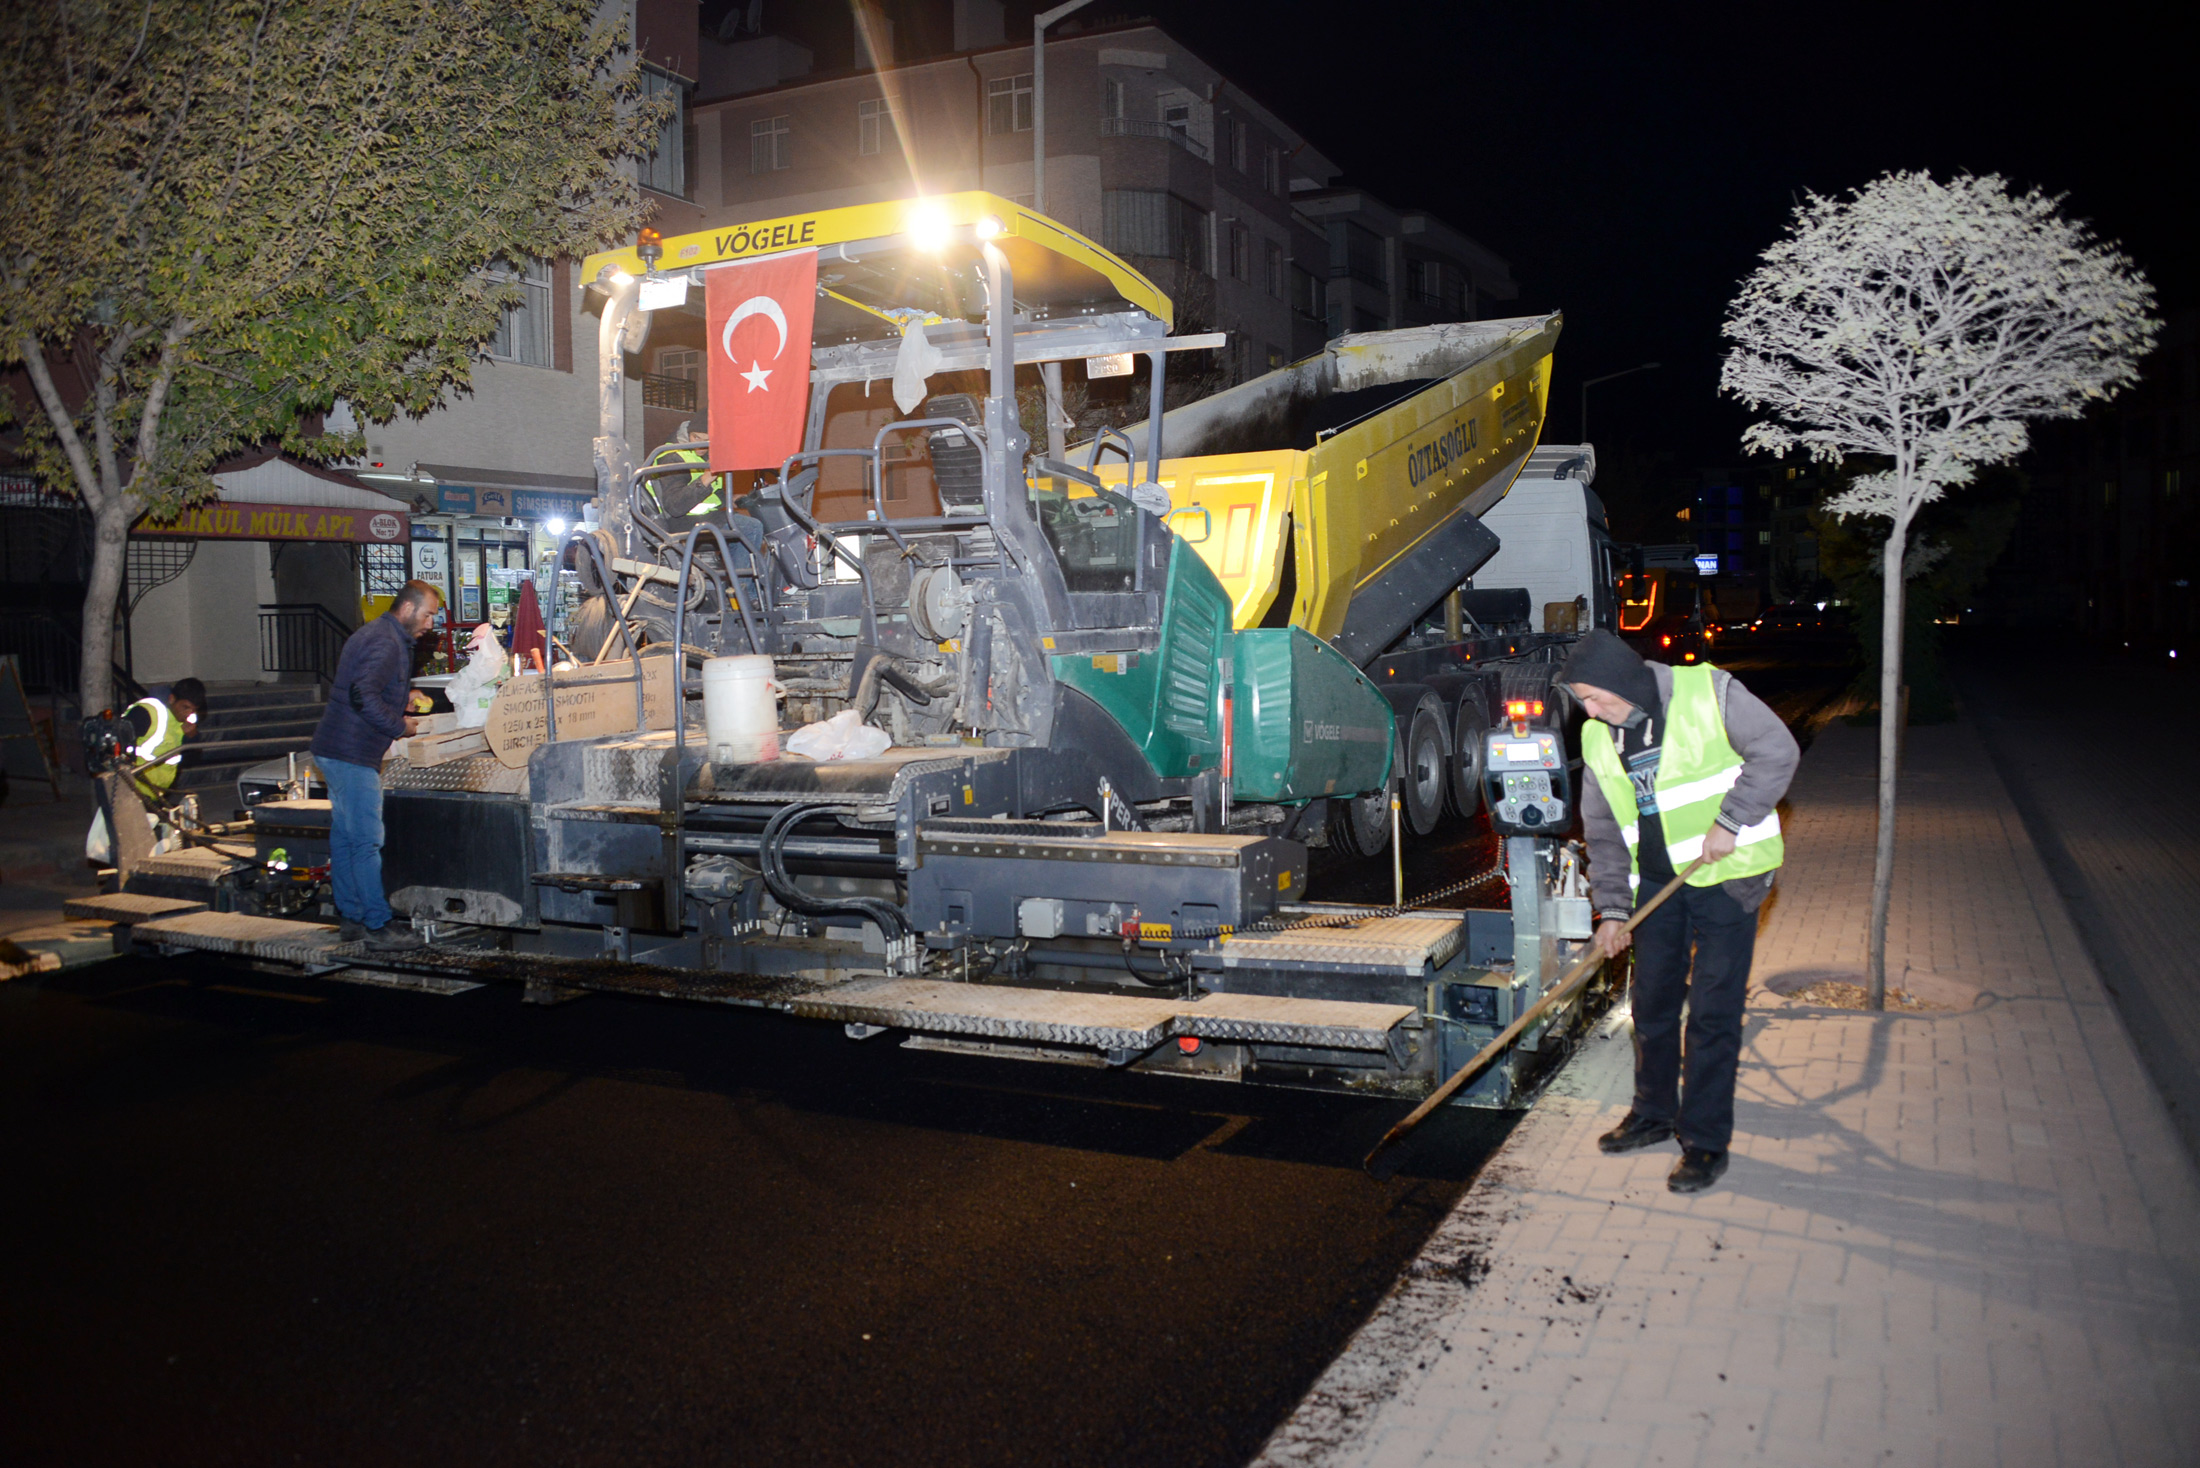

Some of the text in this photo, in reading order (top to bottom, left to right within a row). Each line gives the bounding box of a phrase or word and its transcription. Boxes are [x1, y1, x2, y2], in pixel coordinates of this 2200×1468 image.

[714, 219, 816, 256] VÖGELE
[1407, 417, 1477, 488] ÖZTAŞOĞLU
[516, 494, 573, 514] ŞİMŞEKLER
[249, 506, 309, 536] MÜLK
[416, 570, 443, 581] FATURA
[503, 691, 595, 716] SMOOTH SMOOTH
[503, 719, 524, 733] 1250
[568, 711, 577, 724] 18
[1314, 720, 1340, 740] VÖGELE
